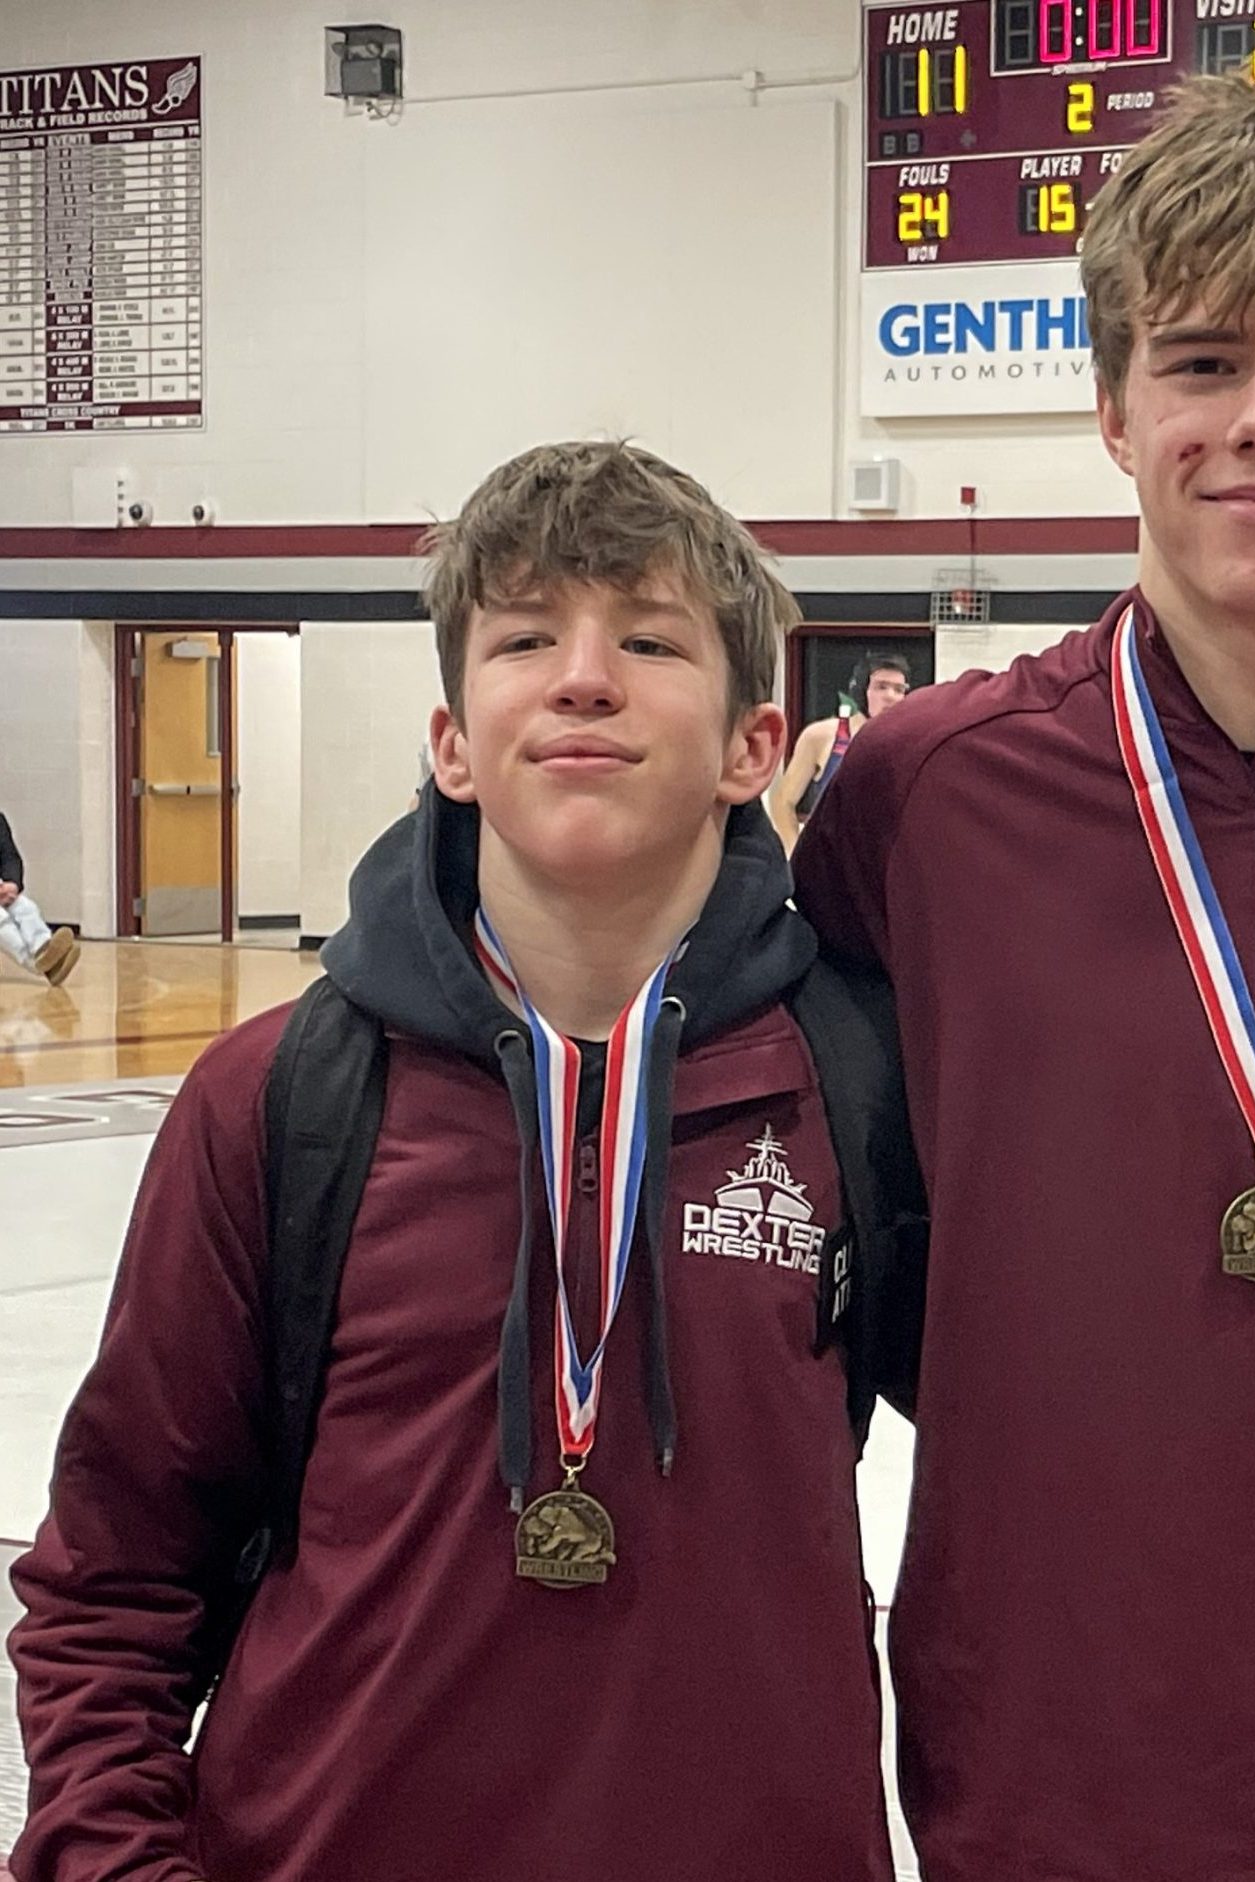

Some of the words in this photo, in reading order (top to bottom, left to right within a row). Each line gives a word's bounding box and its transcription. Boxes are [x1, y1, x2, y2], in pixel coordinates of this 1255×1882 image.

[887, 10, 959, 45] HOME
[0, 65, 149, 116] TITANS
[918, 45, 967, 116] 11
[1067, 83, 1094, 132] 2
[1107, 92, 1154, 110] PERIOD
[0, 117, 33, 130] RACK
[899, 164, 949, 187] FOULS
[1021, 155, 1082, 178] PLAYER
[1100, 152, 1124, 174] FO
[899, 191, 949, 241] 24
[1038, 184, 1075, 232] 15
[907, 245, 938, 262] WON
[884, 361, 1085, 382] AUTOMOTIV
[683, 1203, 826, 1255] DEXTER
[682, 1231, 822, 1275] WRESTLING
